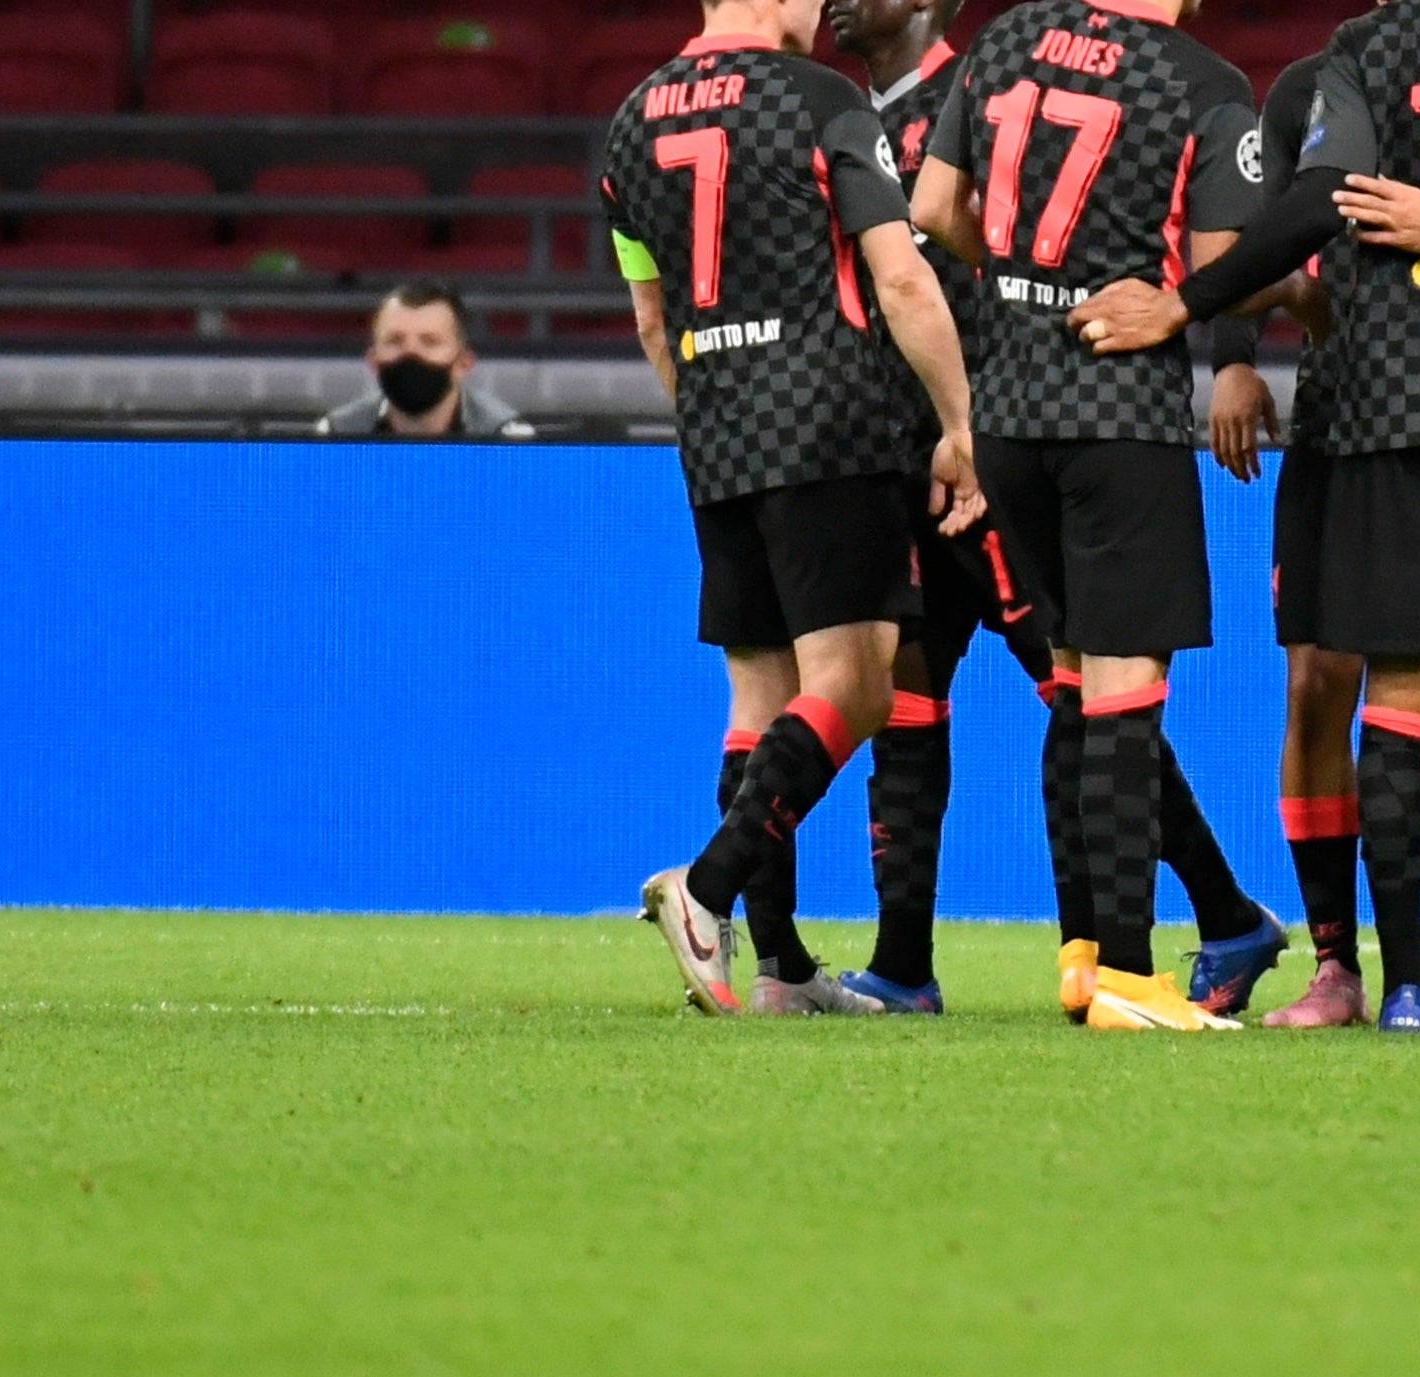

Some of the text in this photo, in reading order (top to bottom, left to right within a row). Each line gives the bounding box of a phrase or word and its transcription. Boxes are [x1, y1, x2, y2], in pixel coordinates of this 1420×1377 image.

[1032, 28, 1124, 75] JONES
[644, 74, 745, 120] MILNER
[985, 79, 1122, 269] 17
[655, 126, 729, 308] 7
[1033, 282, 1054, 306] TO
[722, 323, 744, 348] TO
[744, 318, 782, 345] PLAY
[1390, 1016, 1420, 1028] COPA
